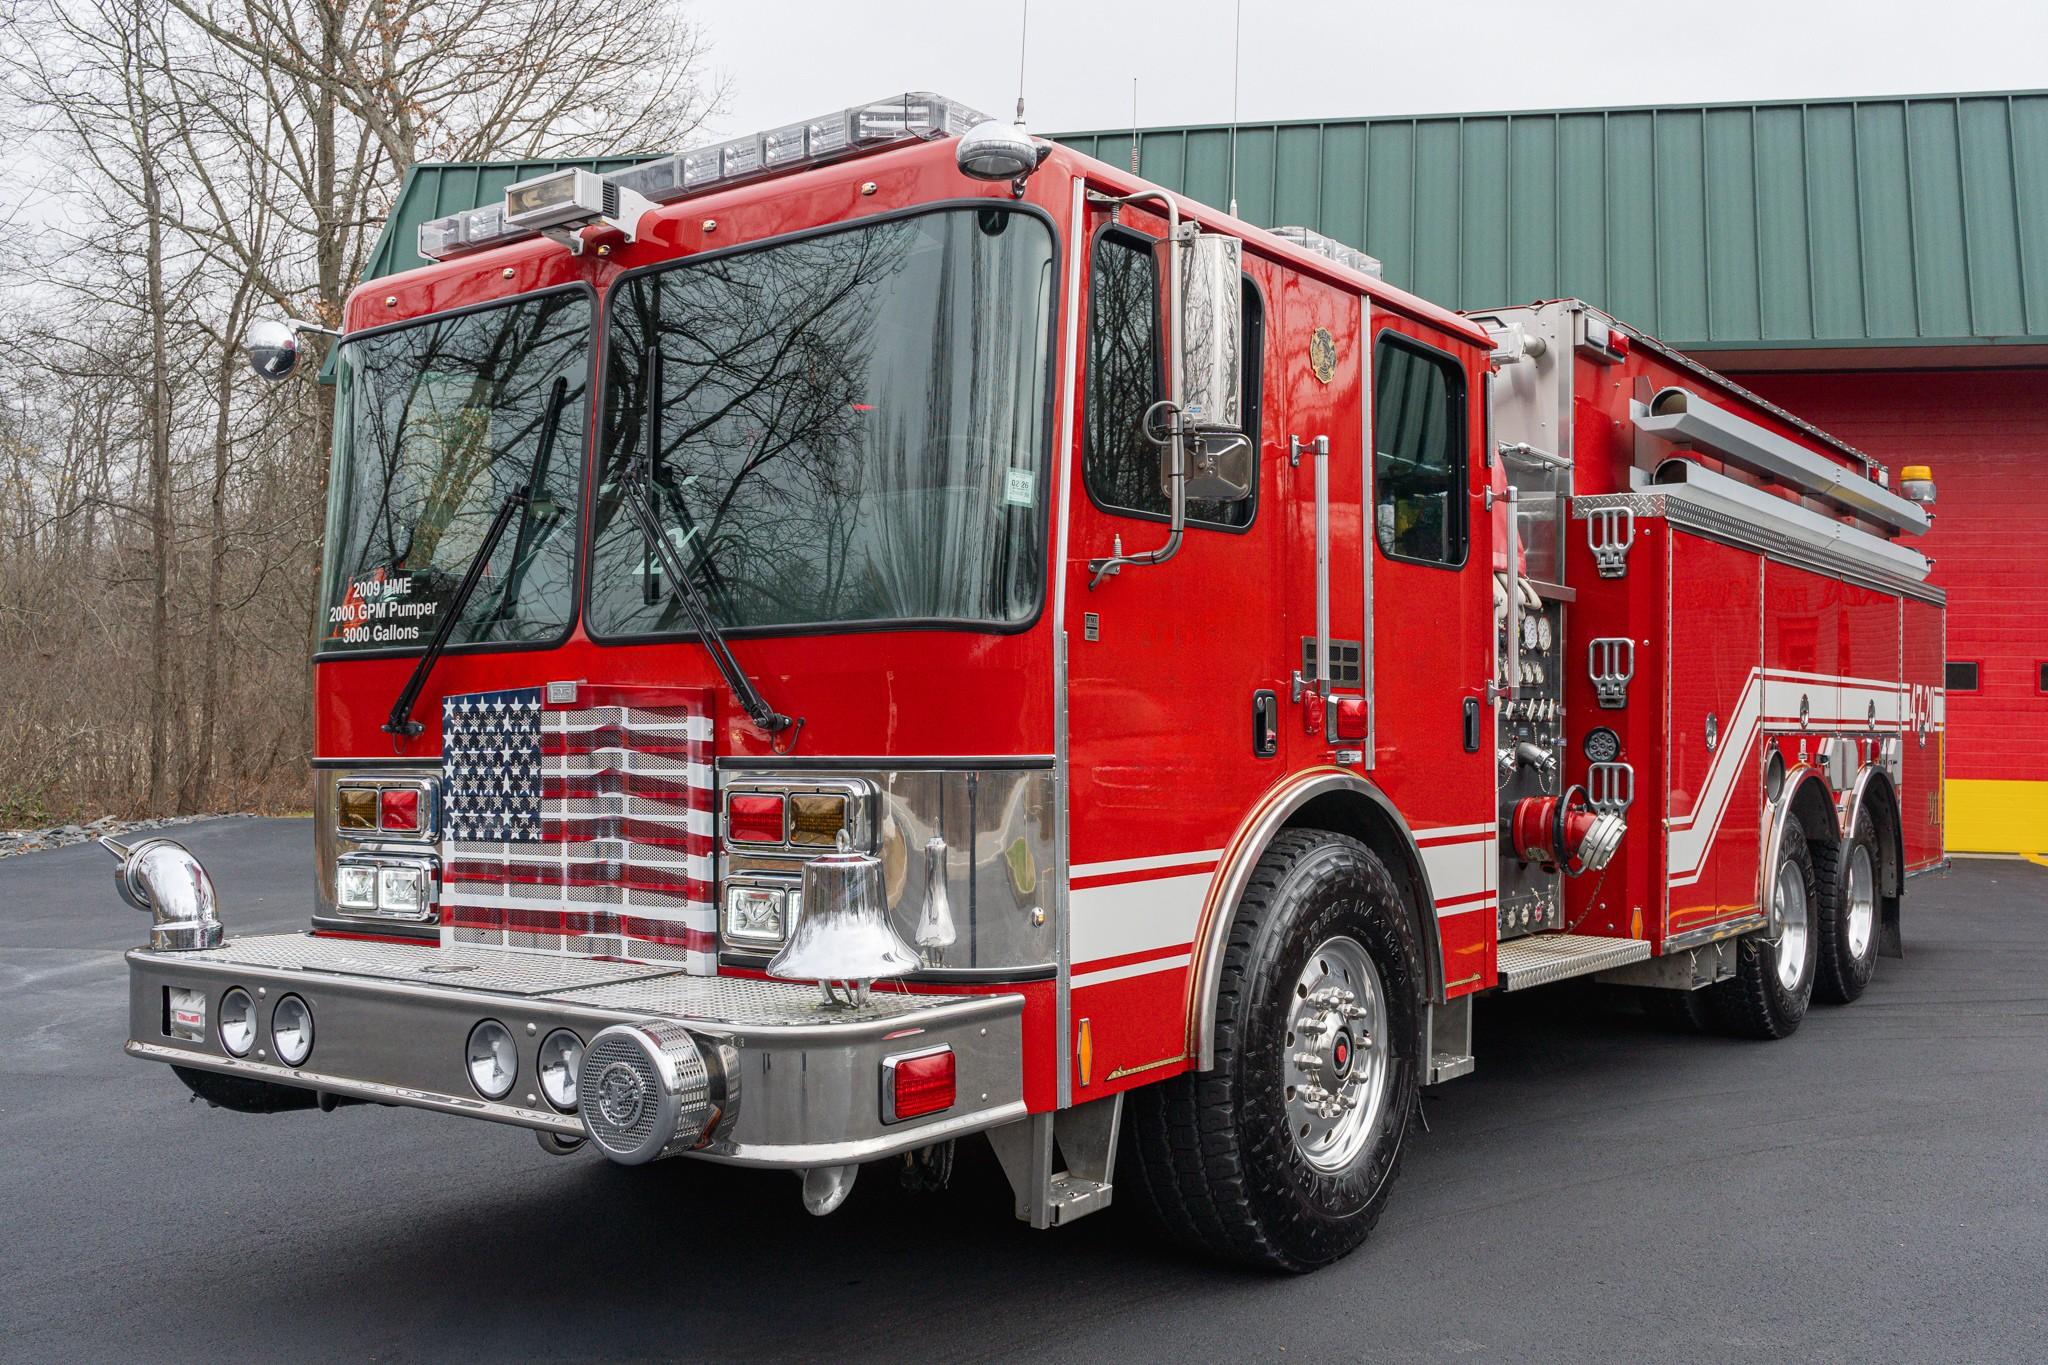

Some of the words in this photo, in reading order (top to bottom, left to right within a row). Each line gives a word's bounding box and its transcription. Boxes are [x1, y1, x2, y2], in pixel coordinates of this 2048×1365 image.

[353, 582, 380, 598] 2009
[384, 577, 412, 595] HME
[329, 606, 355, 622] 2000
[358, 603, 386, 619] GPM
[389, 602, 438, 619] Pumper
[343, 627, 370, 643] 3000
[373, 625, 419, 641] Gallons
[1909, 683, 1935, 733] 47-20
